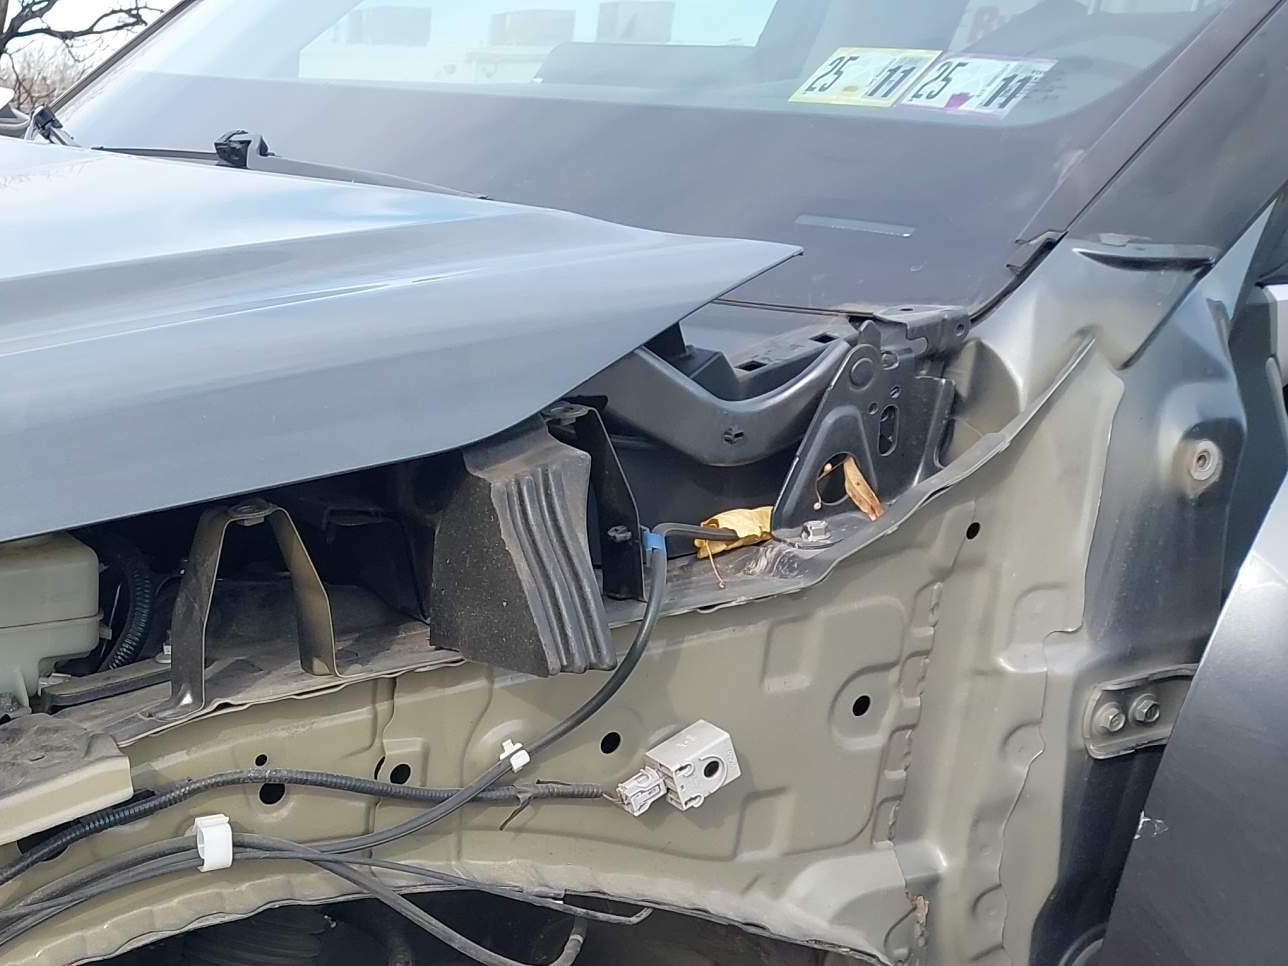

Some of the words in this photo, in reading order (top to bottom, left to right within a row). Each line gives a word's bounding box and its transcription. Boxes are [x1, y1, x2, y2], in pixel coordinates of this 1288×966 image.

[804, 55, 861, 95] 25
[866, 64, 918, 98] 11
[910, 61, 969, 101] 25
[981, 73, 1034, 109] 11
